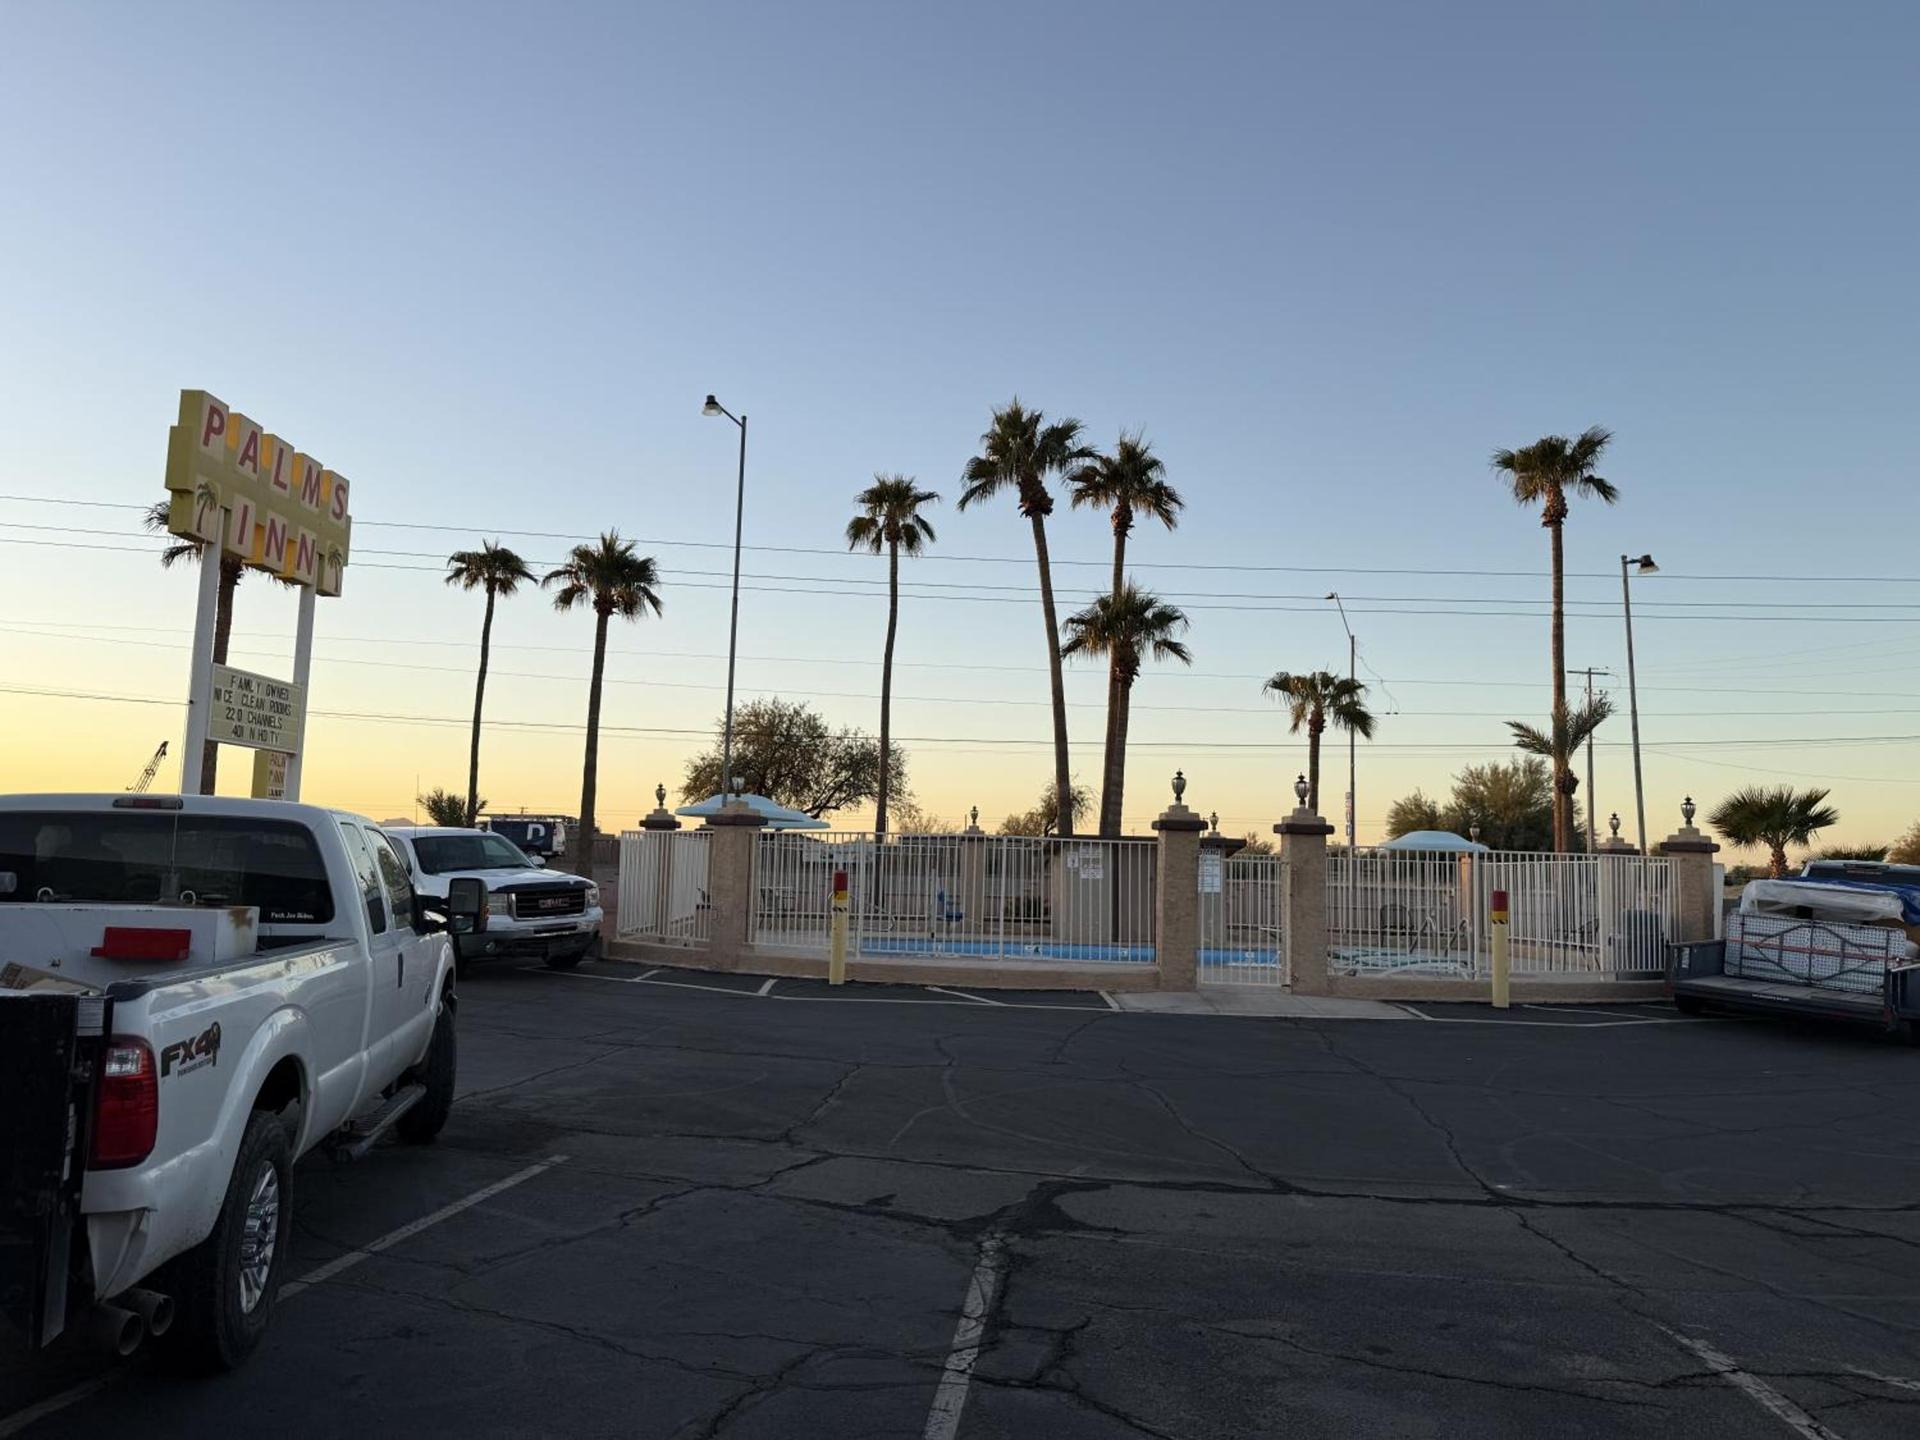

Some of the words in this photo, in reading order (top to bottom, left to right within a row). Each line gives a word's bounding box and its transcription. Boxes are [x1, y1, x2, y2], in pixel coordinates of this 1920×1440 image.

[203, 404, 347, 521] PALMS
[237, 504, 316, 576] INN
[241, 693, 266, 712] CLEAN
[161, 1021, 221, 1078] FX4
